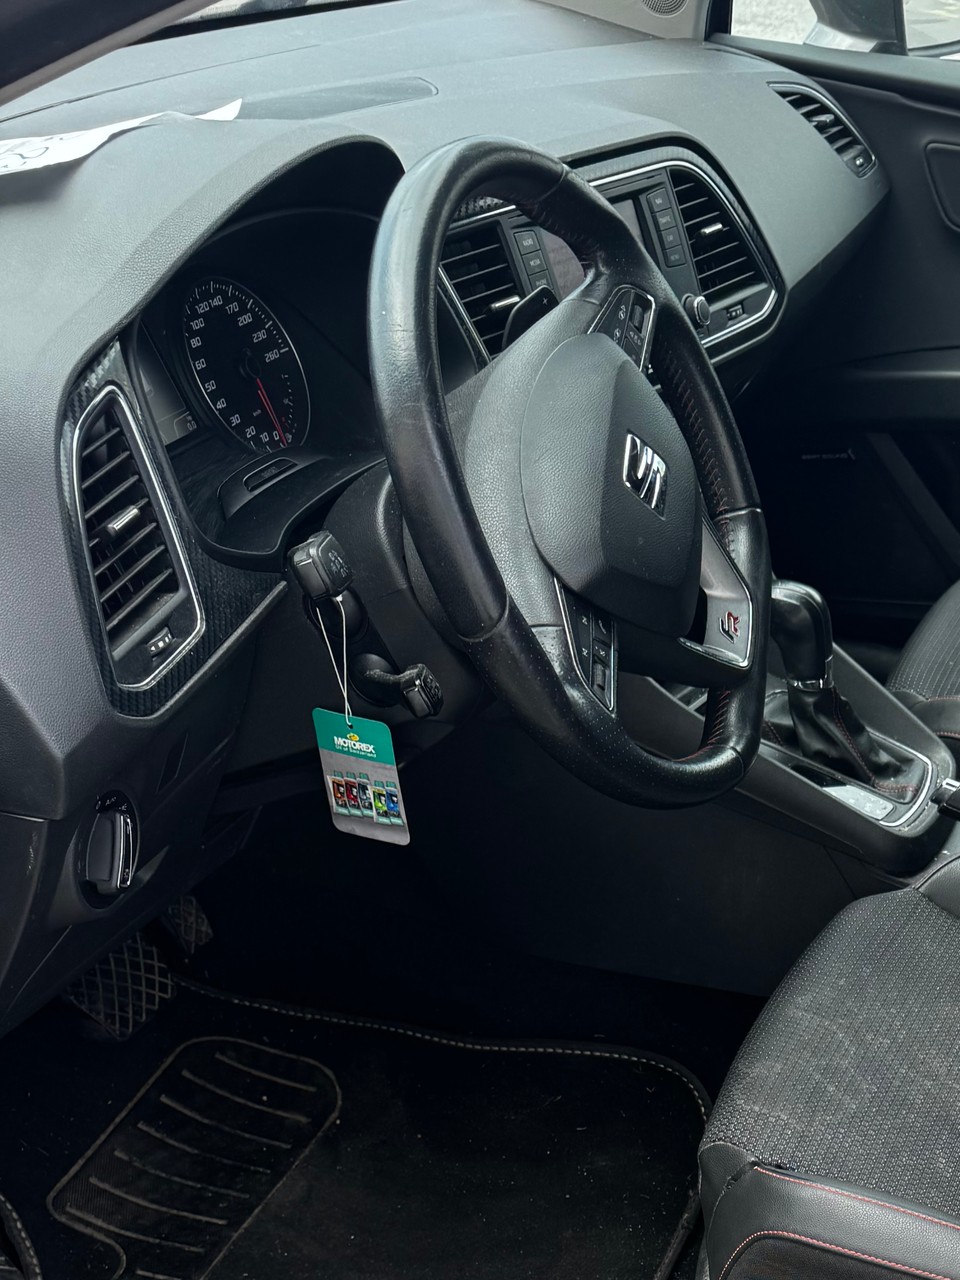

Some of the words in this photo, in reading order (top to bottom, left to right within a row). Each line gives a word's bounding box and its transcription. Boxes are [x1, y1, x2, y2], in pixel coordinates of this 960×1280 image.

[195, 301, 210, 314] 120
[208, 295, 223, 308] 140
[225, 302, 239, 315] 170
[190, 317, 205, 331] 100
[237, 312, 253, 327] 200
[190, 336, 202, 348] 80
[252, 329, 267, 343] 230
[264, 349, 280, 363] 260
[195, 358, 207, 370] 60
[205, 380, 217, 392] 50
[216, 398, 227, 409] 40
[229, 414, 241, 427] 30
[245, 425, 256, 438] 20
[259, 432, 269, 443] 10
[272, 431, 280, 441] 0
[719, 611, 740, 643] FR
[333, 735, 376, 754] MOTOREX
